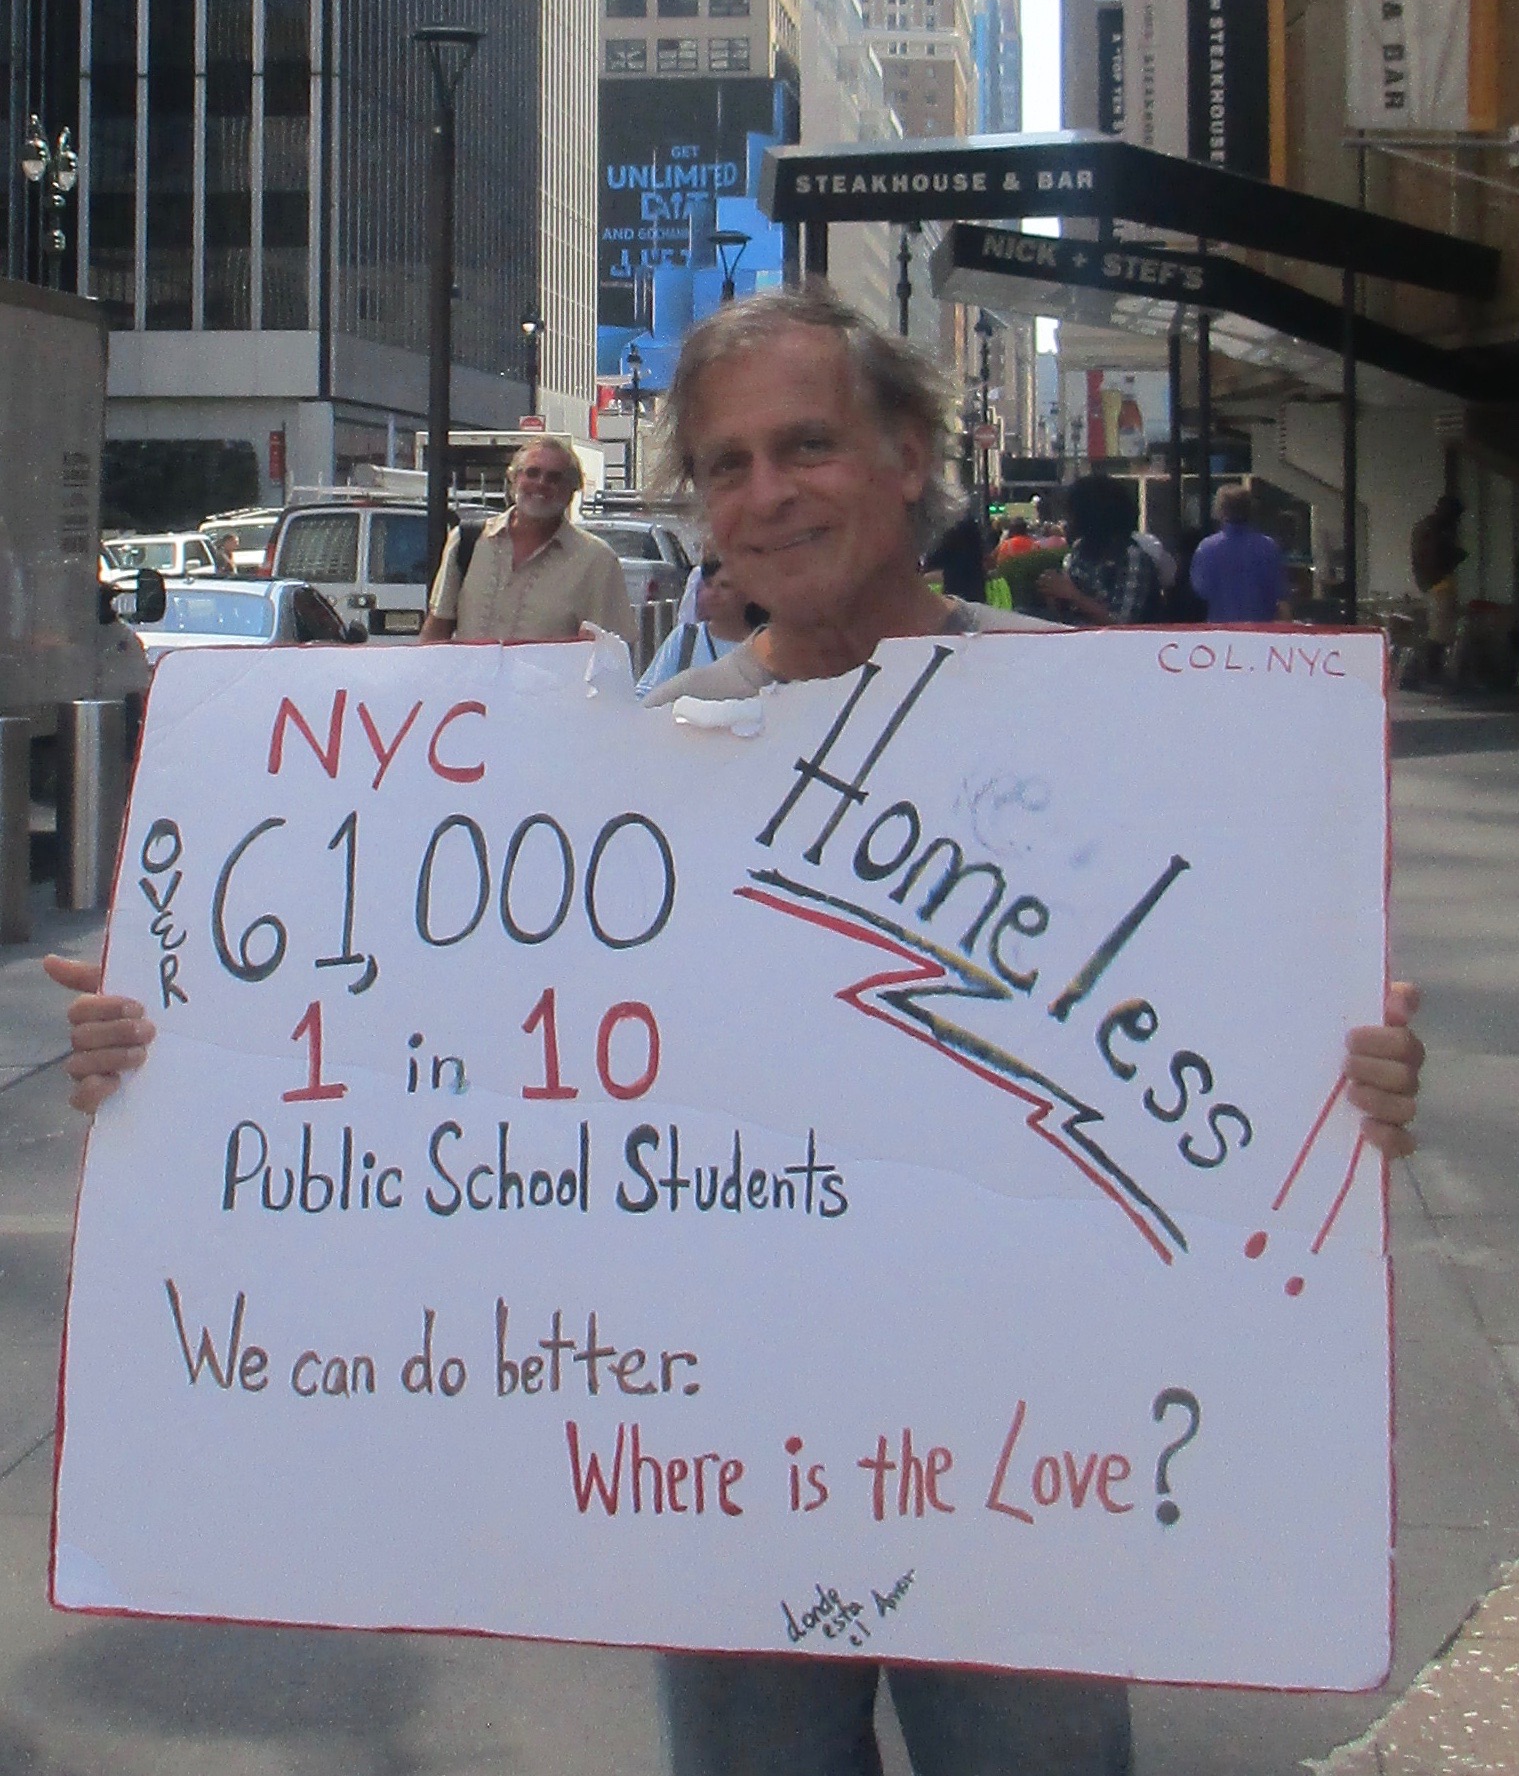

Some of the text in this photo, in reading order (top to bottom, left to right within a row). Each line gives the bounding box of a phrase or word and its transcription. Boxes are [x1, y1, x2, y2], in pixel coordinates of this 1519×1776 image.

[1383, 44, 1405, 109] BAR
[606, 162, 738, 189] UNLIMITED
[670, 145, 700, 160] GET
[796, 170, 1095, 195] STEAKHOUSE & BAR
[602, 228, 635, 241] AND
[981, 234, 1057, 268] NICK
[1103, 252, 1204, 291] STEF'S
[267, 688, 487, 792] NYC
[211, 810, 676, 995] 61,000
[755, 644, 1253, 1169] Homeless
[281, 987, 661, 1103] 1 in 10
[222, 1119, 849, 1219] Public School Students
[165, 1278, 269, 1393] We
[291, 1350, 376, 1398] can
[400, 1308, 467, 1397] do
[565, 1420, 744, 1517] Where
[784, 1436, 829, 1512] is
[856, 1428, 956, 1522] the
[781, 1583, 841, 1643] donde
[822, 1601, 864, 1639] esta
